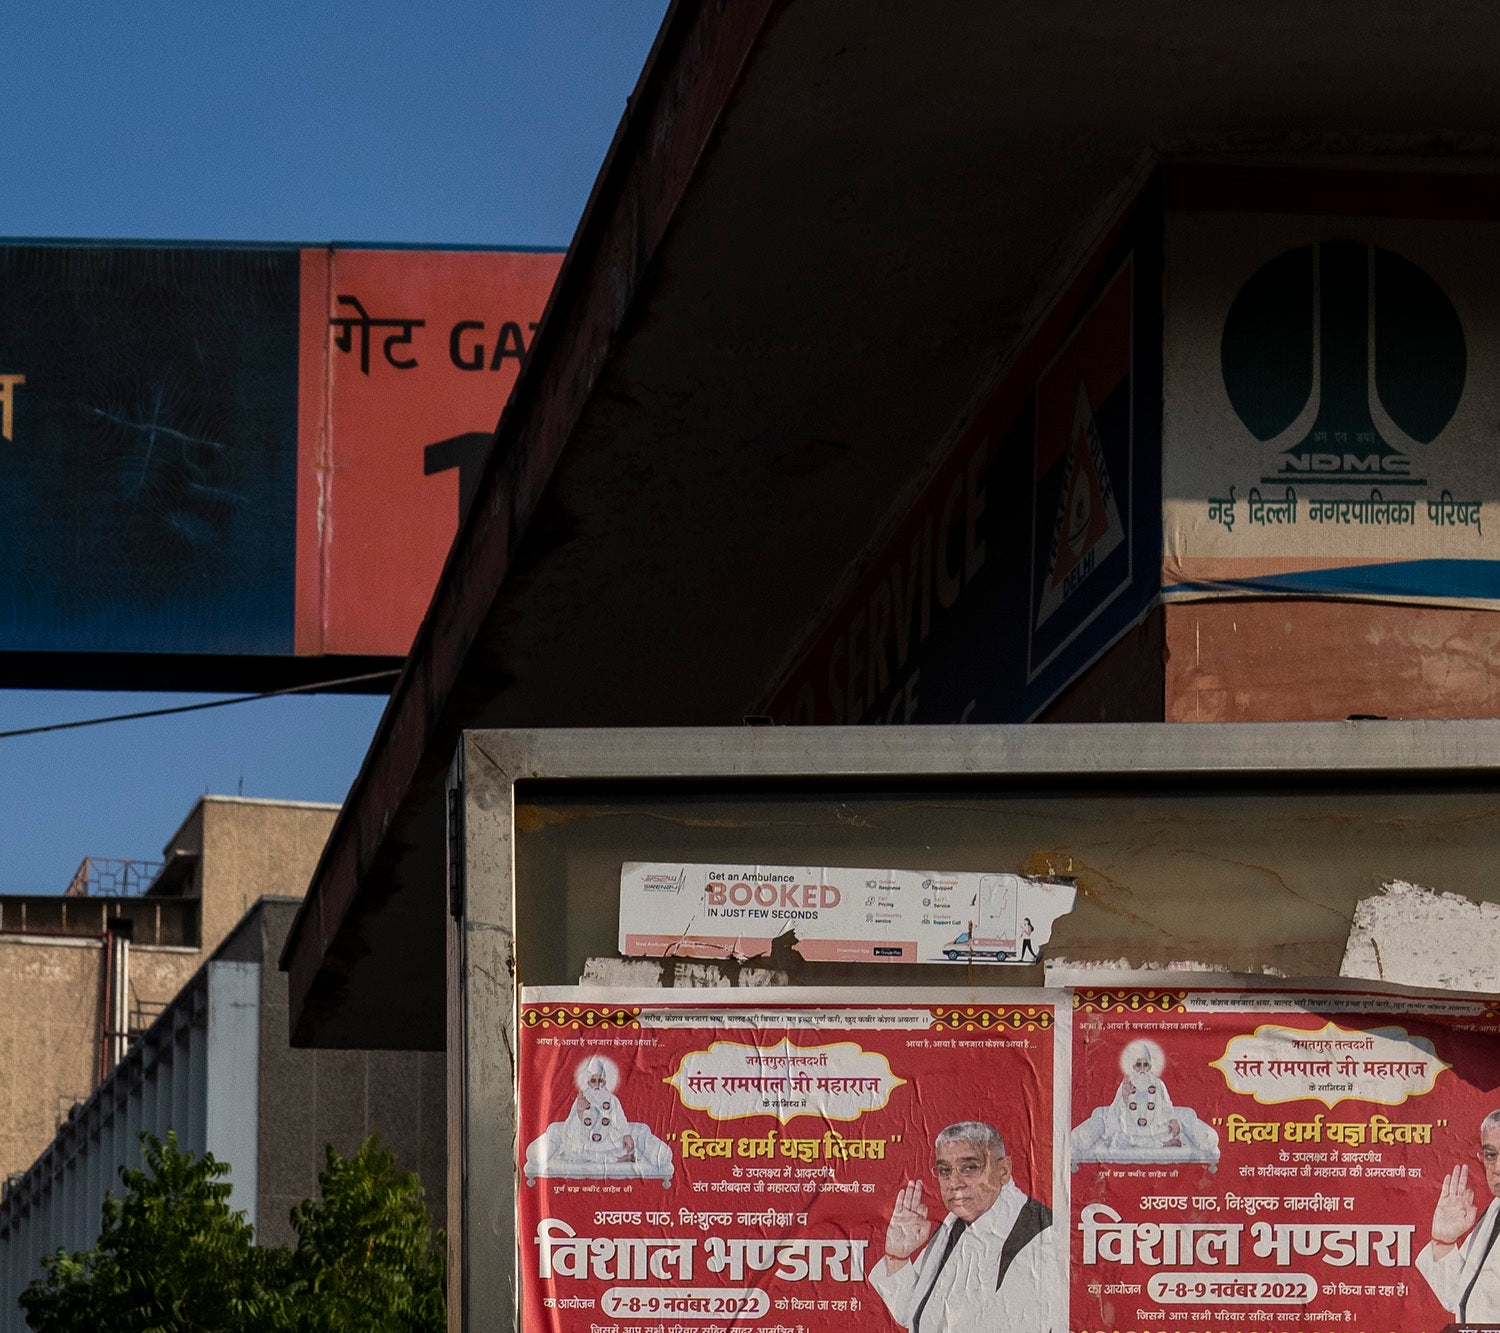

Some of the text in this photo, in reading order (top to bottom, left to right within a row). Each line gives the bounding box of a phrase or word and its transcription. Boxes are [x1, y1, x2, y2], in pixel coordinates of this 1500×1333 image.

[328, 295, 541, 377] गेट GA
[1282, 453, 1411, 473] NDMC
[1208, 486, 1482, 537] नई दिल्ली नगरपालिका परिषद्
[709, 872, 795, 882] Get an Ambulance
[708, 882, 841, 908] BOOKED
[707, 908, 818, 919] IN JUST FEW SECONDS
[688, 1071, 882, 1096] संत रामपाल जी महाराज
[681, 1129, 887, 1163] दिव्य धर्म यज्ञ दिवस
[593, 1211, 642, 1226] अखण्ड
[646, 1211, 674, 1227] पाठ,
[737, 1207, 793, 1227] नामदीक्षा
[796, 1213, 808, 1226] व
[1078, 1203, 1416, 1267] विशाल भण्डारा
[534, 1218, 869, 1282] विशाल भण्डारा
[1158, 1279, 1308, 1299] 7-8-9 नवंबर 2022
[611, 1293, 760, 1313] 7-8-9 नवंबर 2022
